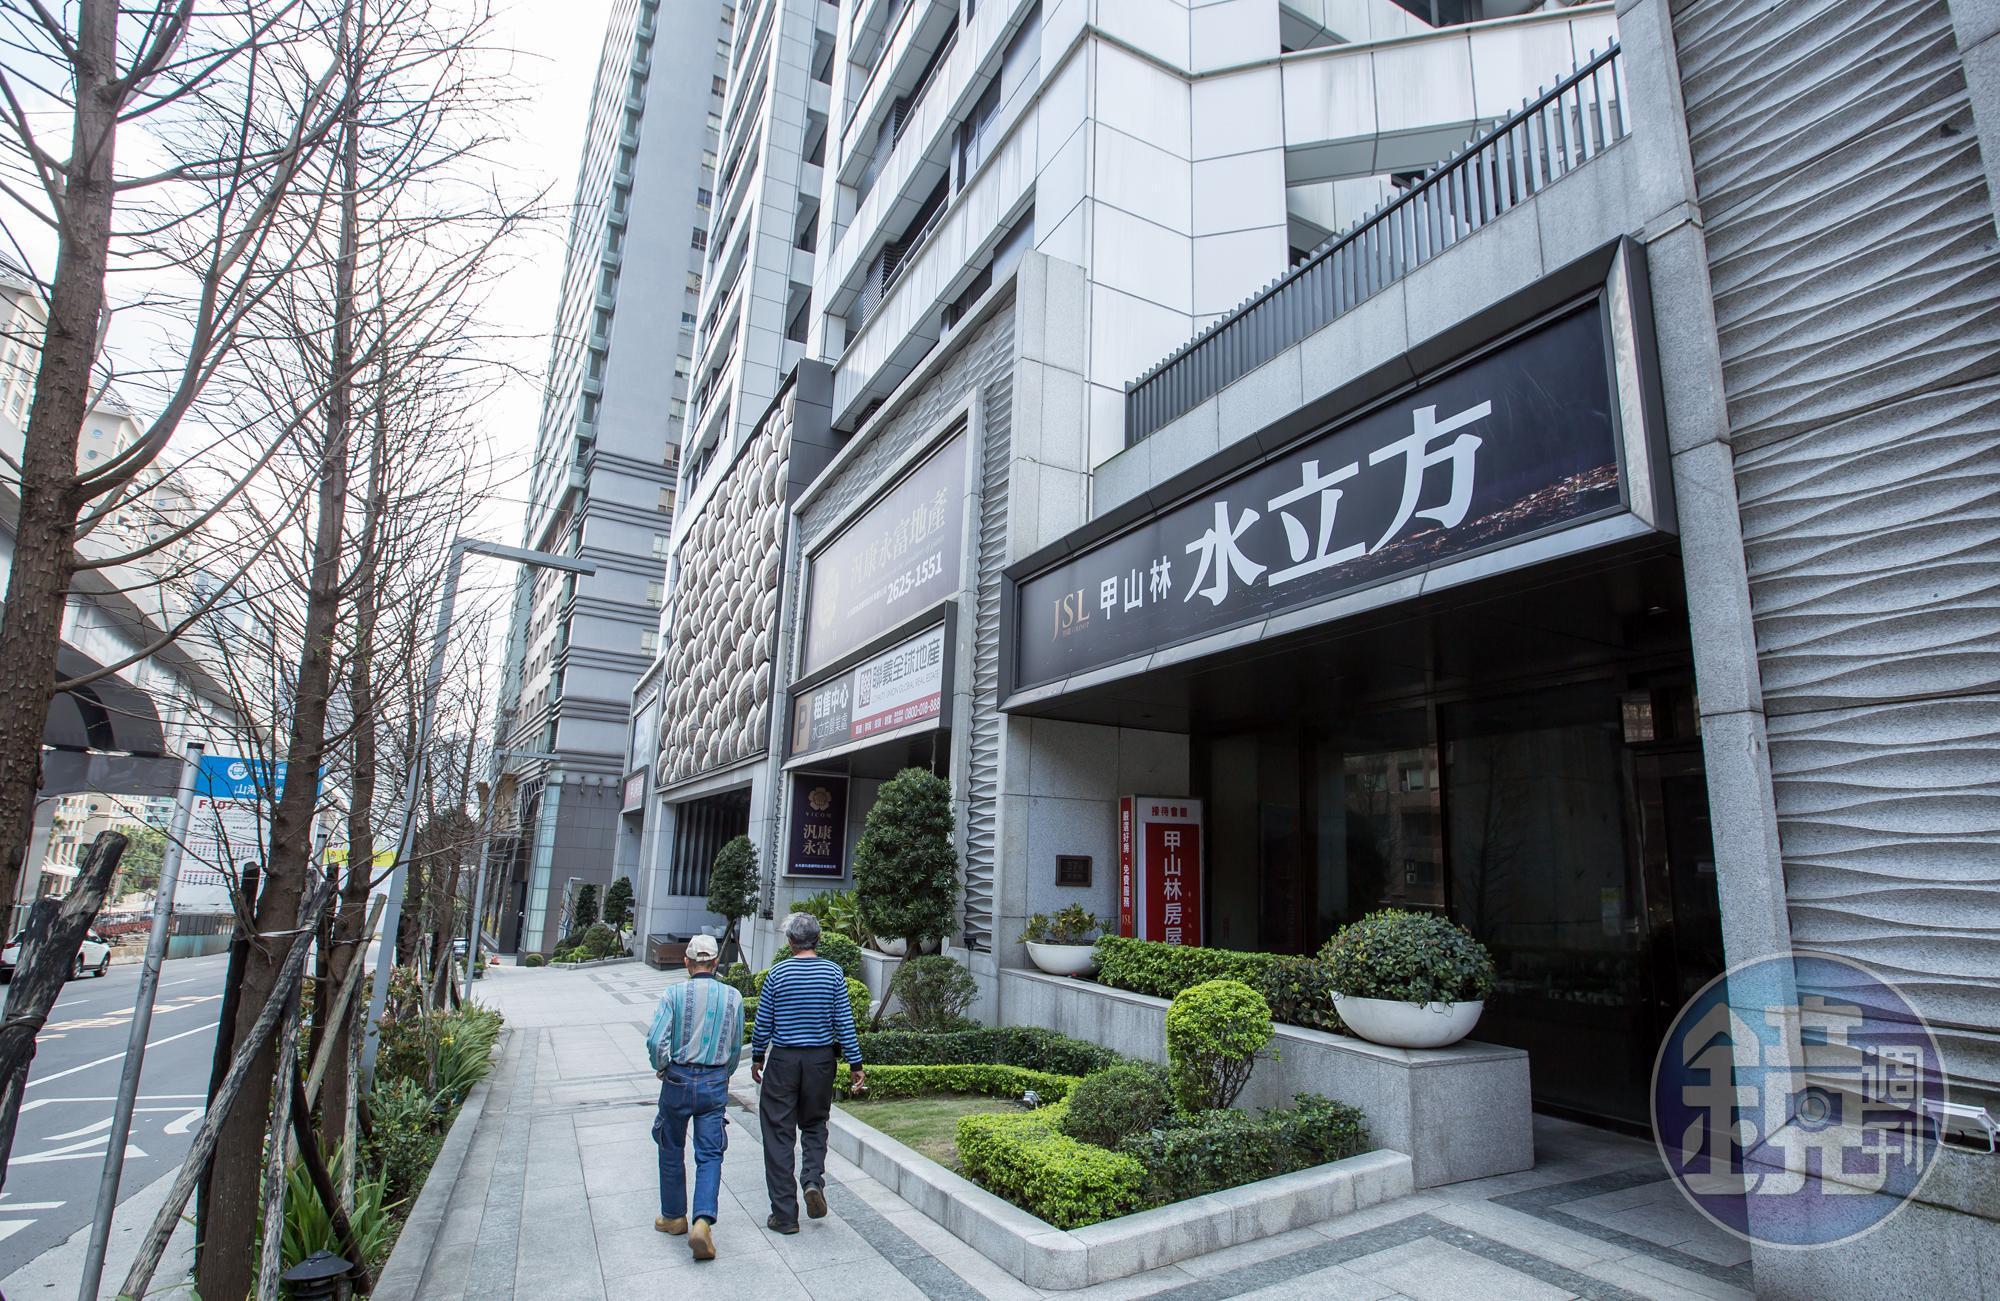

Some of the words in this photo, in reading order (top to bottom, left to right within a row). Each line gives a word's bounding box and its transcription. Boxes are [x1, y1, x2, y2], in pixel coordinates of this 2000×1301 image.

[1052, 589, 1090, 641] JSL
[1100, 554, 1171, 620] 甲山林
[1183, 400, 1493, 607] 水立方
[886, 551, 943, 605] 2625-1551
[814, 682, 849, 720] 租售中心
[802, 841, 830, 855] 永富
[1164, 831, 1182, 945] 甲山林房屋
